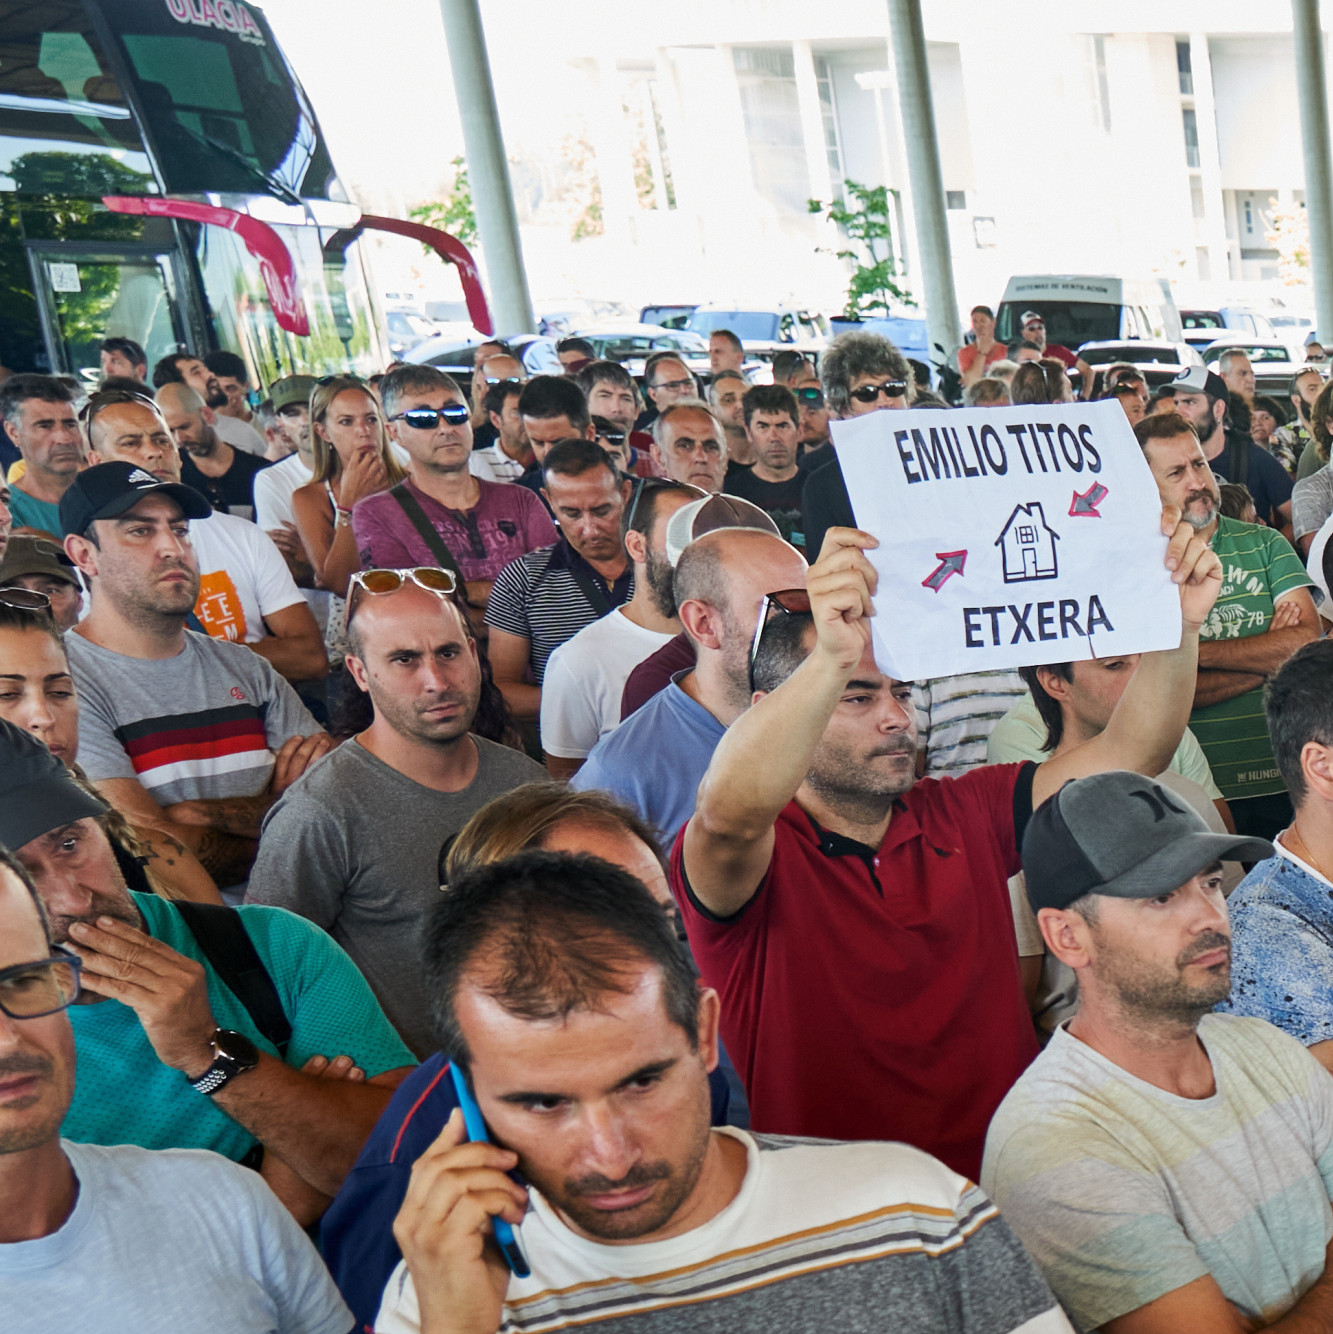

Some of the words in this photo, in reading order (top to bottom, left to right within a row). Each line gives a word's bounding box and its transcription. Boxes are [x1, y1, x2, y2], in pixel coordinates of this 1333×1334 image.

[165, 0, 263, 38] ULACIA
[894, 423, 1008, 484] EMILIO
[1005, 422, 1102, 474] TITOS
[962, 594, 1115, 648] ETXERA
[1247, 610, 1265, 629] 78
